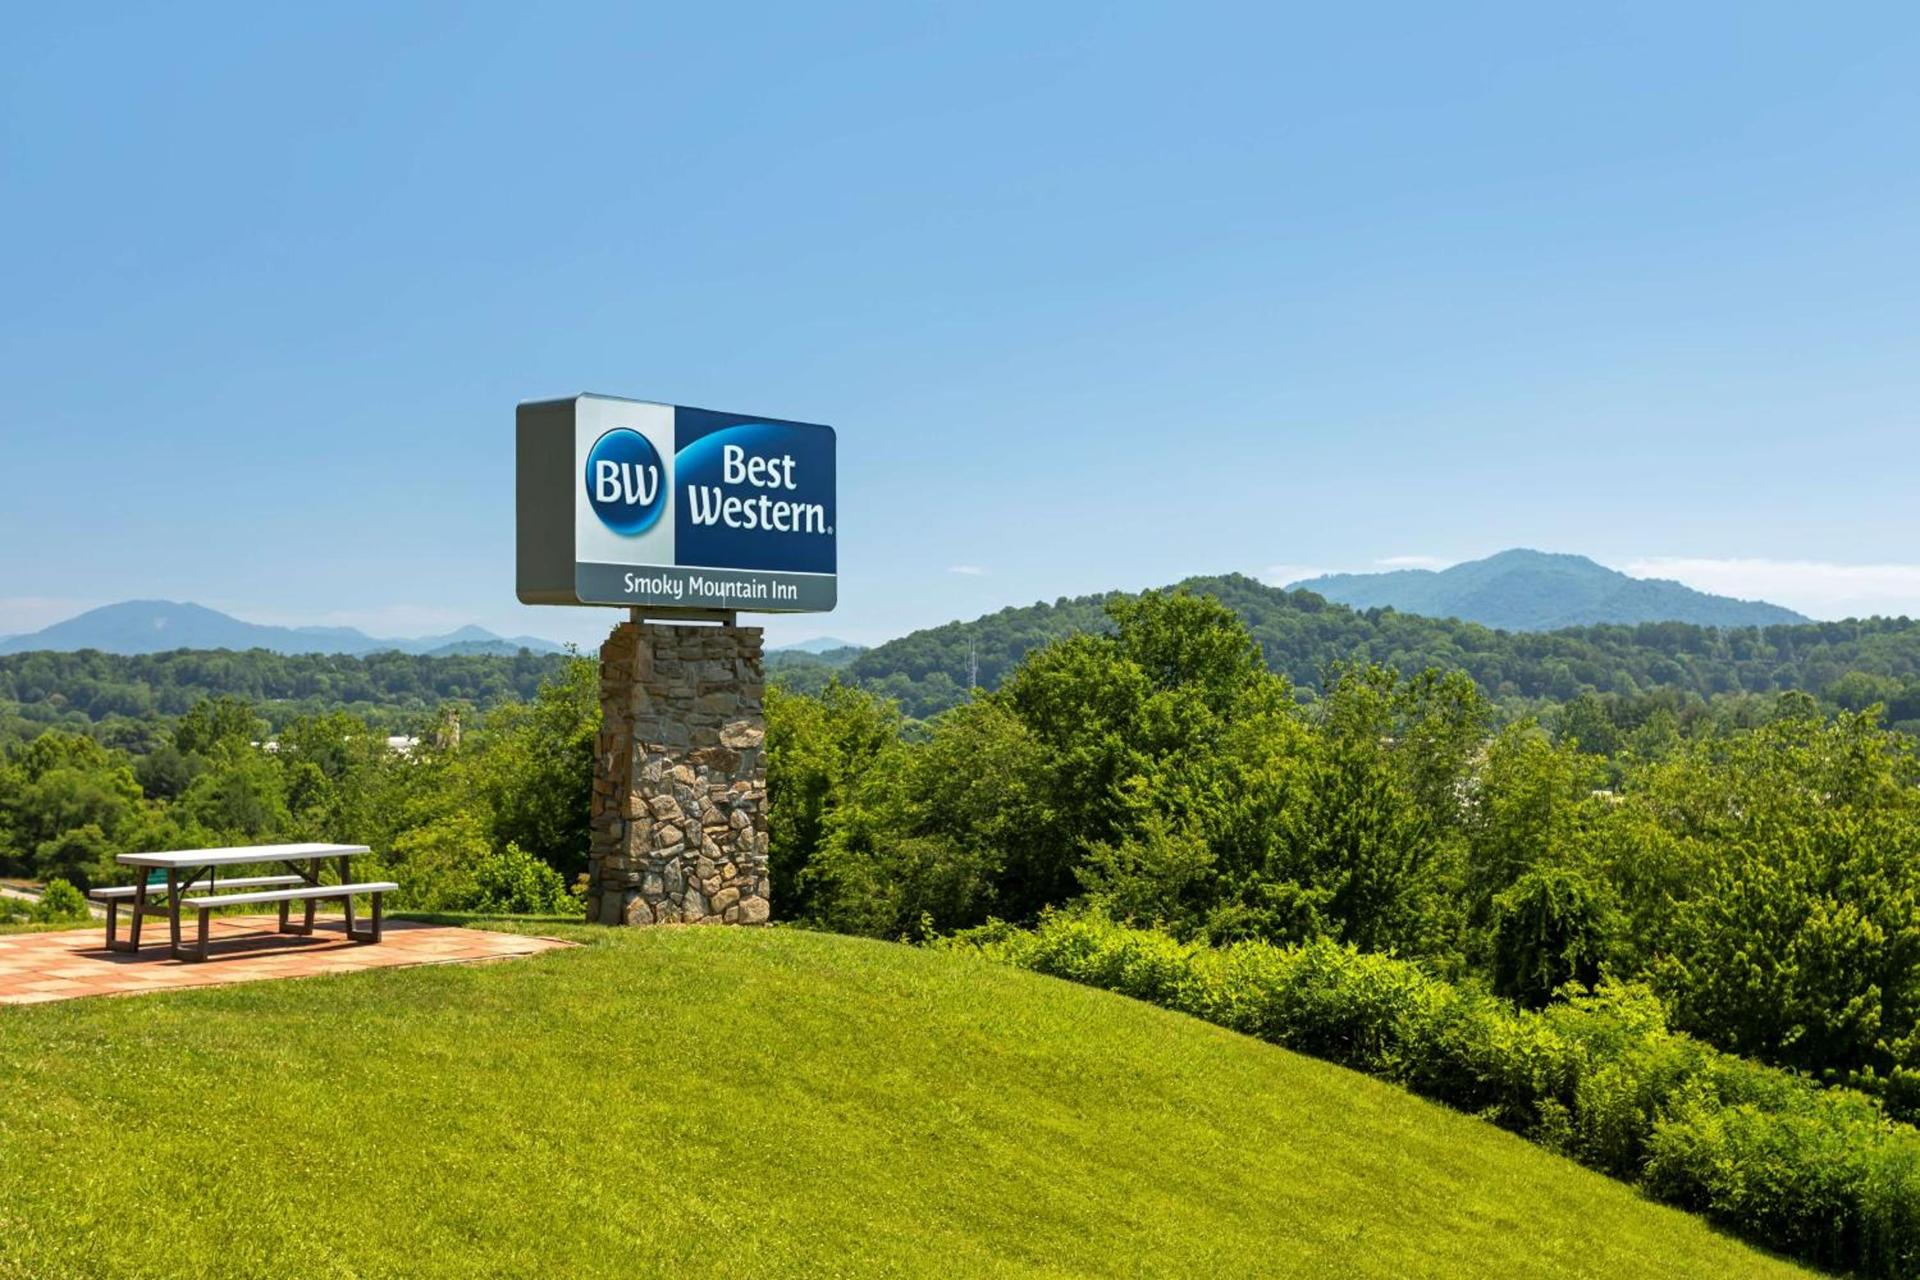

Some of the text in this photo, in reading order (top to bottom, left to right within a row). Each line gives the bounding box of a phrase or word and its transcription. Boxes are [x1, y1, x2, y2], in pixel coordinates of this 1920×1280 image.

[595, 460, 658, 507] BW
[723, 445, 797, 490] Best
[688, 484, 826, 535] Western
[623, 573, 798, 600] Smoky Mountain Inn
